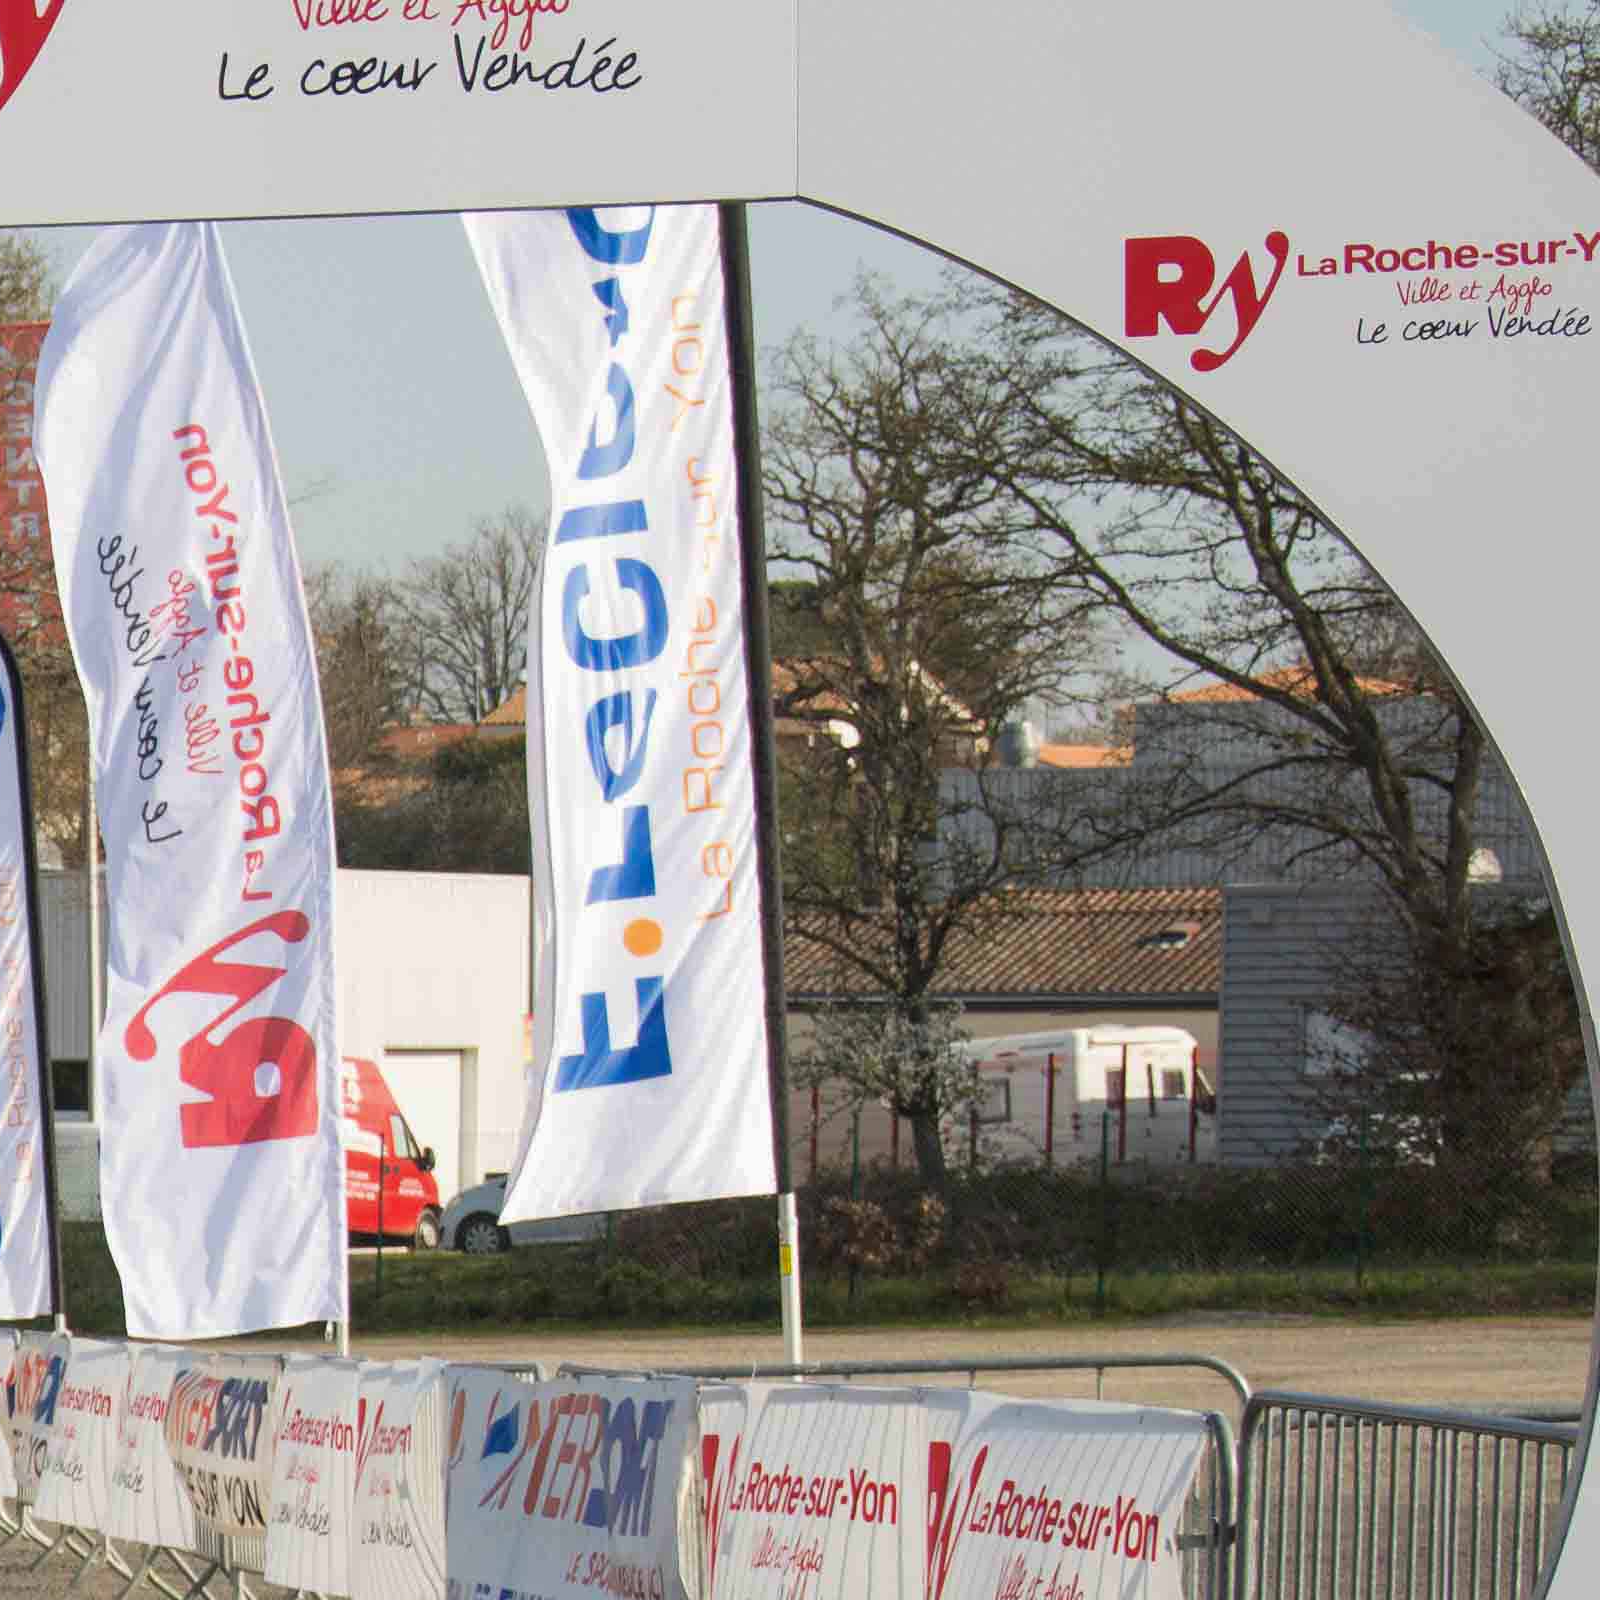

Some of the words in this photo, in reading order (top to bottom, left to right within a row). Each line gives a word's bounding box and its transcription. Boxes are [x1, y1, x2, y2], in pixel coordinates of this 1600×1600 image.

[218, 52, 274, 102] Le
[453, 35, 642, 94] Vendée
[1125, 231, 1290, 371] Ry
[1297, 253, 1337, 277] La
[1396, 280, 1453, 305] Ville
[1458, 282, 1482, 301] et
[1486, 273, 1553, 315] Agglo
[663, 292, 706, 432] Yon
[1356, 317, 1388, 344] Le
[1487, 306, 1593, 339] Vendée
[679, 594, 725, 817] Roche
[699, 840, 734, 922] La
[745, 1461, 897, 1527] Roche-sur-Yon
[990, 1479, 1160, 1563] Roche-sur-Yon
